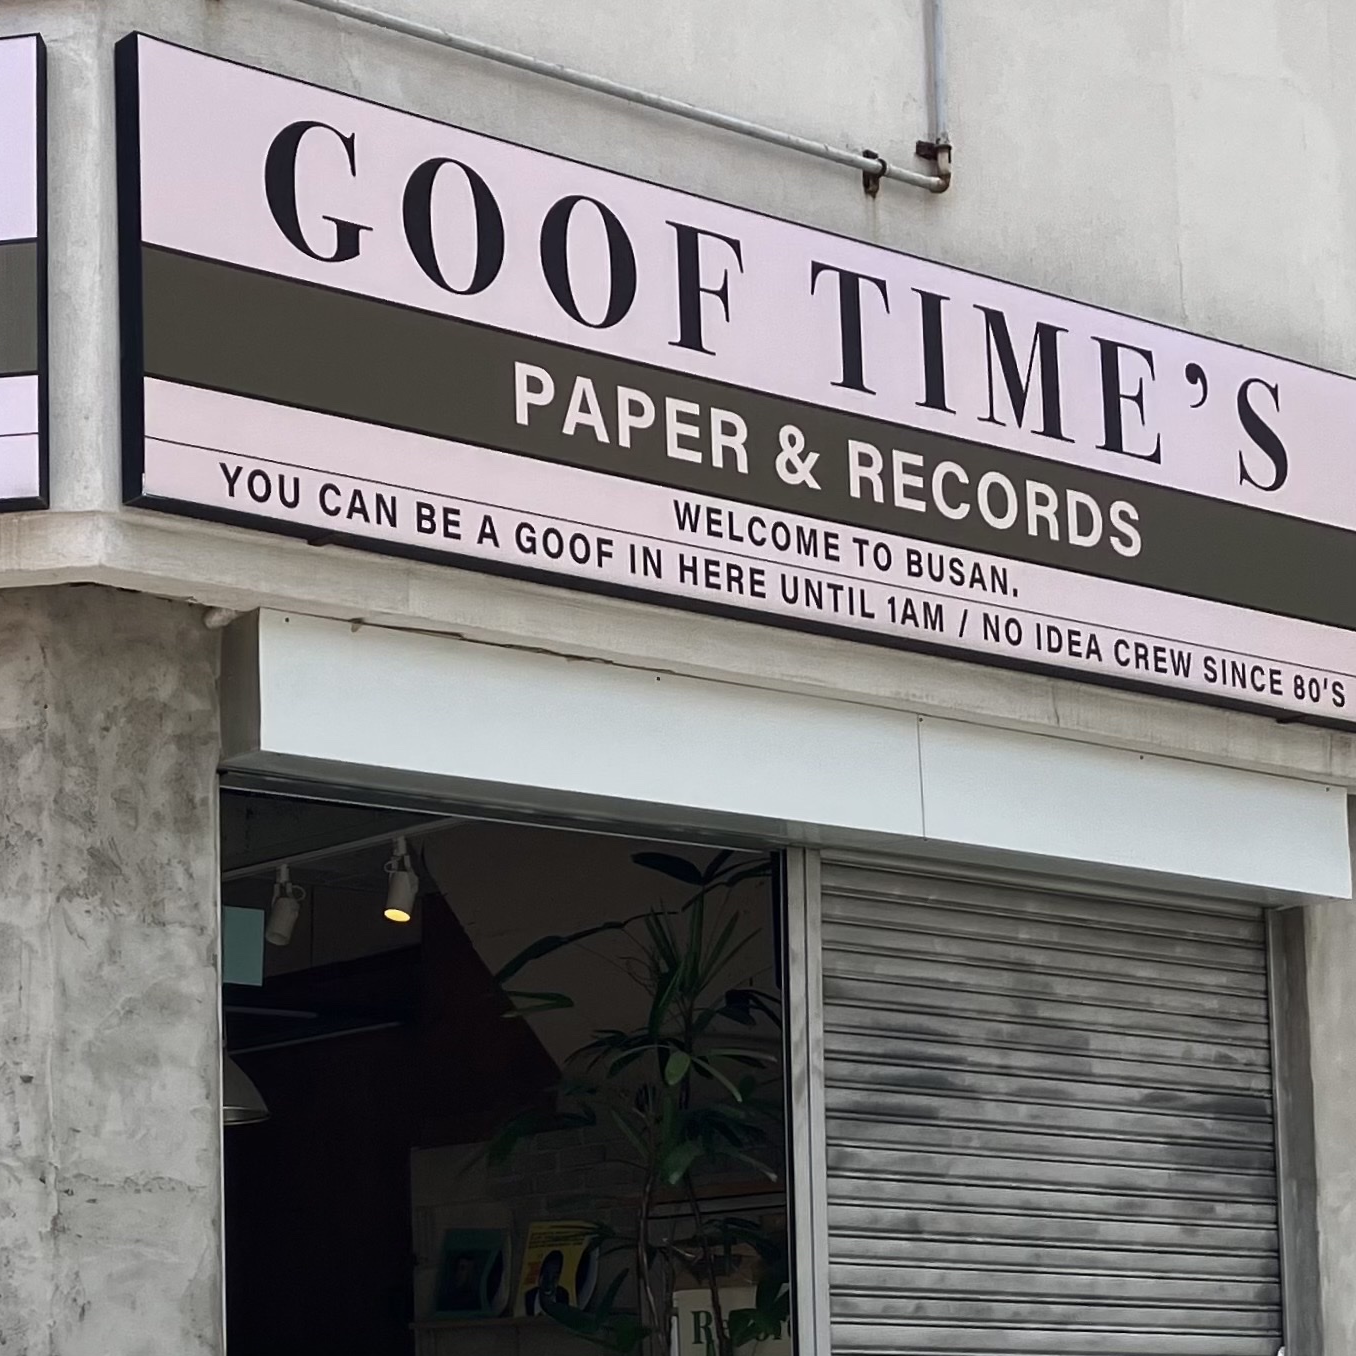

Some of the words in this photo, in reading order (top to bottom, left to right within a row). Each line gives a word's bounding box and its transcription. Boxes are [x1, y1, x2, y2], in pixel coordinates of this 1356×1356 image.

[264, 120, 745, 356] GOOF
[810, 260, 1290, 492] TIME'S
[513, 360, 750, 475] PAPER
[774, 424, 822, 491] &
[847, 438, 1143, 557] RECORDS
[673, 499, 841, 563] WELCOME
[852, 536, 893, 573] TO
[906, 547, 1020, 598] BUSAN.
[218, 461, 300, 508] YOU
[317, 481, 398, 529] CAN
[416, 500, 462, 541] BE
[476, 513, 501, 549] A
[514, 520, 615, 569] GOOF
[628, 543, 663, 580] IN
[678, 553, 767, 599] HERE
[780, 573, 876, 620] UNTIL
[886, 596, 944, 634] 1AM
[958, 608, 969, 639] /
[982, 612, 1023, 647] NO
[1035, 623, 1104, 664] IDEA
[1113, 638, 1193, 680] CREW
[1202, 655, 1284, 697] SINCE
[1292, 673, 1346, 709] 80'S
